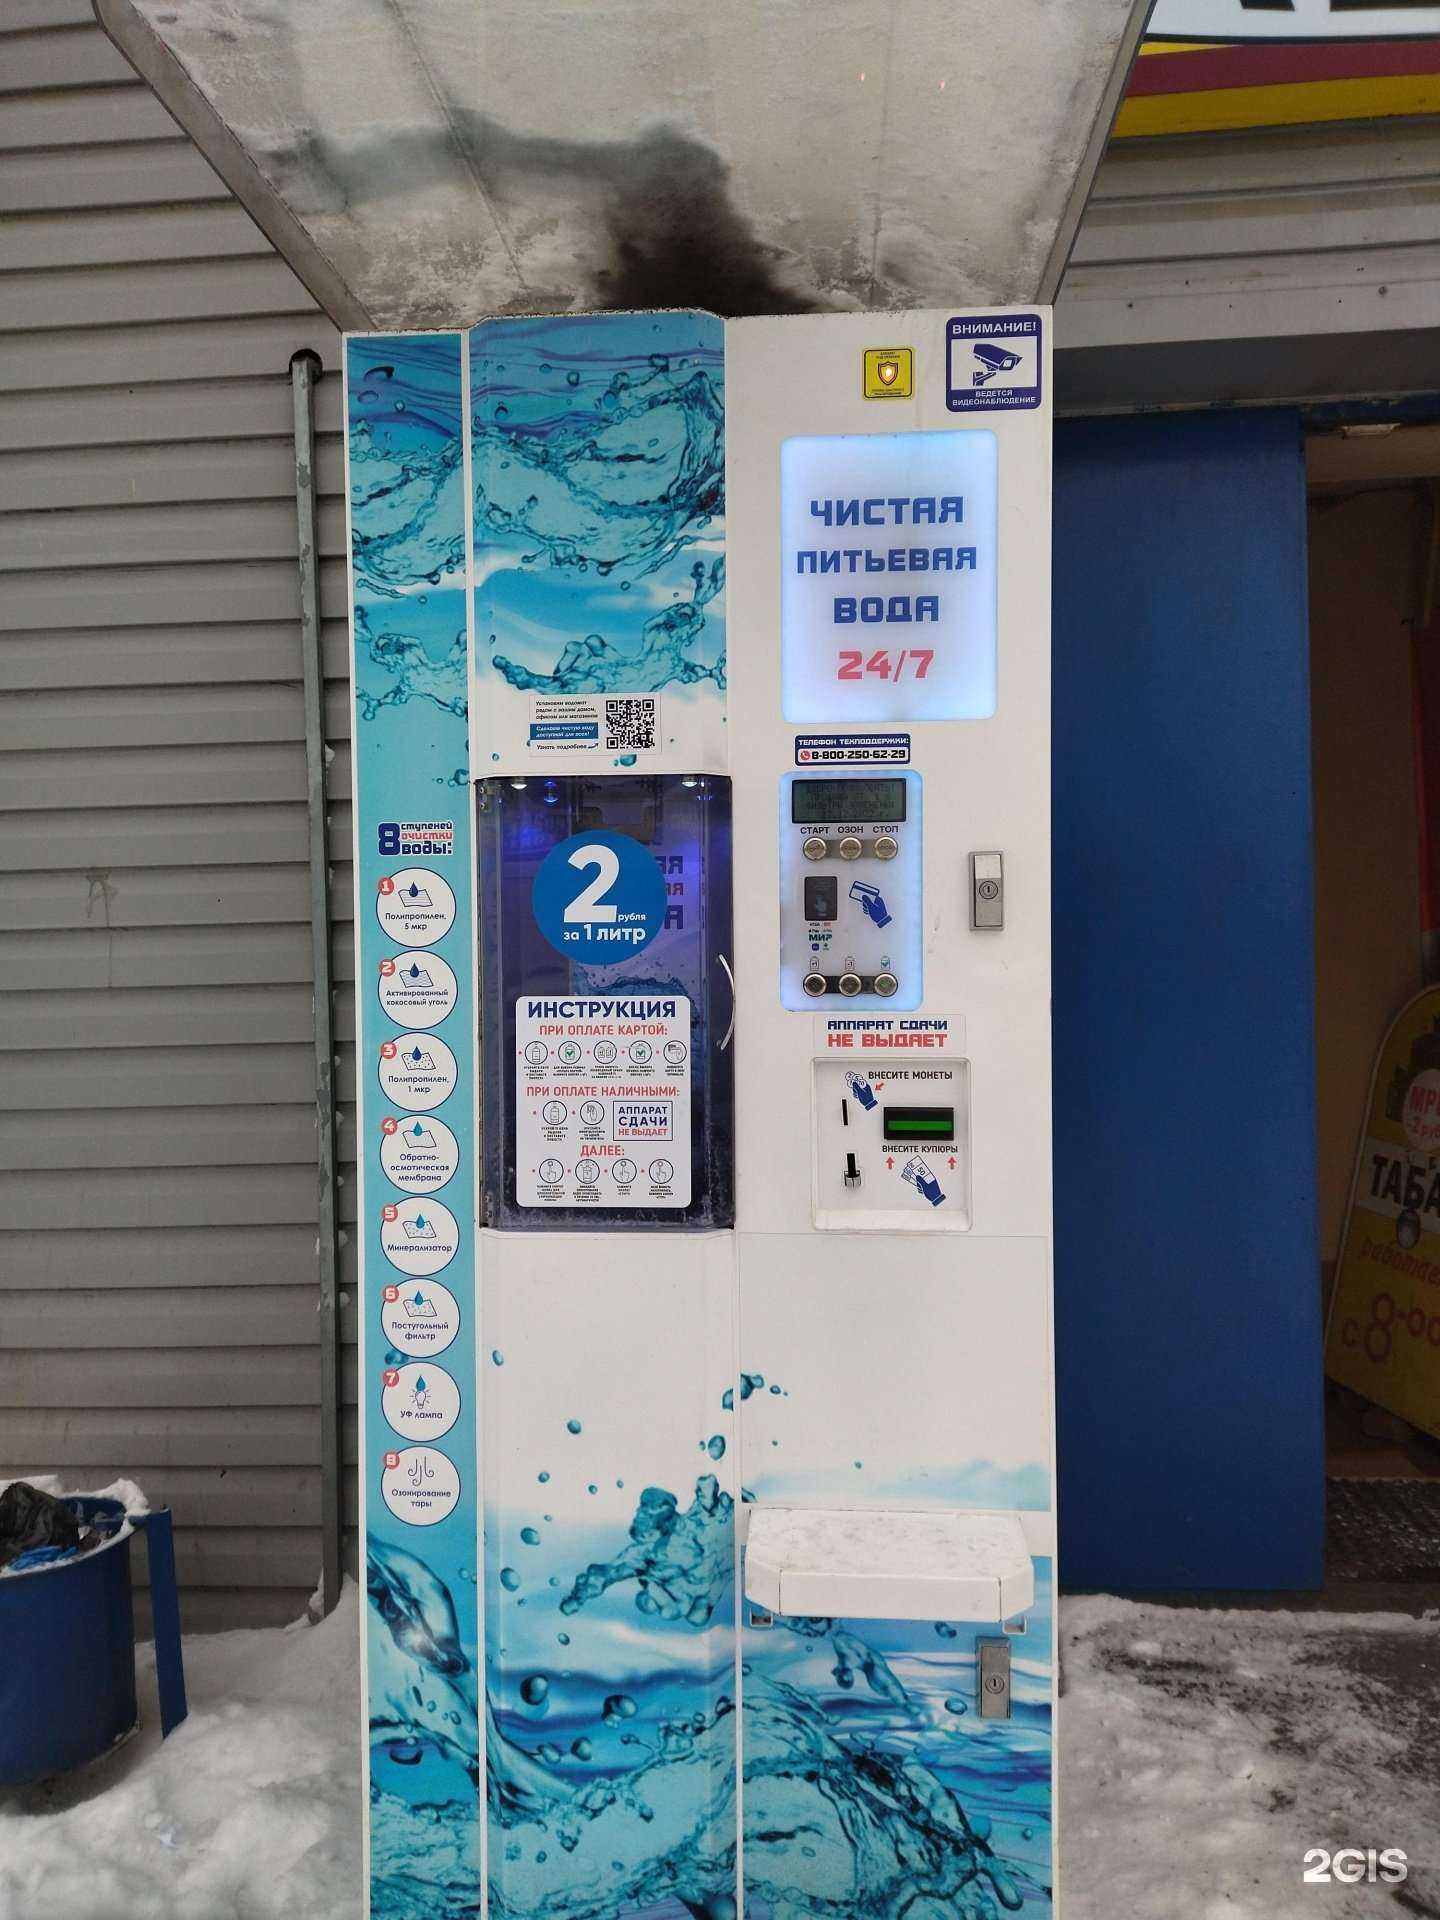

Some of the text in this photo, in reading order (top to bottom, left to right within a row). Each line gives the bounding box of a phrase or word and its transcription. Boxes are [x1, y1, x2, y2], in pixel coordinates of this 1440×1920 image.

[952, 321, 1037, 335] ВНИМАНИЕ!
[975, 389, 1013, 398] ВЕДЕТСЯ
[952, 396, 1036, 406] ВИДЕОНАБЛЮДЕНИЕ
[810, 495, 964, 526] ЧИСТАЯ
[797, 546, 977, 574] ПИТЬЕВАЯ
[833, 595, 940, 624] ВОДА
[837, 649, 935, 683] 24/7
[840, 738, 909, 746] ТЕХПОДДЕРЖКИ:
[811, 750, 906, 760] 8-800-250-62-29
[401, 821, 452, 830] ступеней
[800, 825, 899, 834] СТАРТ ОЗОН СТОП
[378, 822, 400, 856] 8
[401, 832, 452, 840] очистки
[402, 840, 452, 855] воды:
[382, 881, 390, 892] 1
[564, 844, 620, 923] 2
[618, 912, 646, 922] рубля
[564, 924, 646, 944] за 1 литр
[808, 934, 832, 942] МИР
[382, 962, 392, 974] 2
[386, 988, 448, 998] Активированный
[428, 1000, 448, 1008] уголь
[528, 1000, 676, 1020] ИНСТРУКЦИЯ
[539, 1022, 668, 1036] ПРИ ОПЛАТЕ КАРТОЙ:
[828, 1020, 948, 1031] АППАРАТ СДАЧИ
[828, 1034, 948, 1048] НЕ ВЫДАЕТ
[384, 1044, 394, 1057] 3
[868, 1071, 953, 1080] ВНЕСИТЕ МОНЕТЫ
[526, 1086, 680, 1097] ПРИ ОПЛАТЕ НАЛИЧНЫМИ:
[618, 1106, 668, 1115] АППАРАТ
[384, 1120, 394, 1132] 4
[618, 1116, 668, 1128] СДАЧИ
[618, 1128, 668, 1137] НЕ ВЫДАЕТ
[580, 1145, 625, 1158] ДАЛЕЕ:
[882, 1145, 958, 1154] ВНЕСИТЕ КУПЮРЫ
[400, 1154, 440, 1162] Обратно-
[398, 1174, 442, 1182] мембрана
[384, 1207, 395, 1220] 5
[388, 1244, 452, 1253] Минерализатор
[392, 1322, 449, 1331] Постугольный
[404, 1332, 436, 1342] фильтр
[386, 1372, 396, 1384] 7
[400, 1410, 443, 1420] УФ лампа
[386, 1454, 396, 1466] 8
[392, 1489, 452, 1499] Озонирование
[411, 1500, 432, 1509] тары
